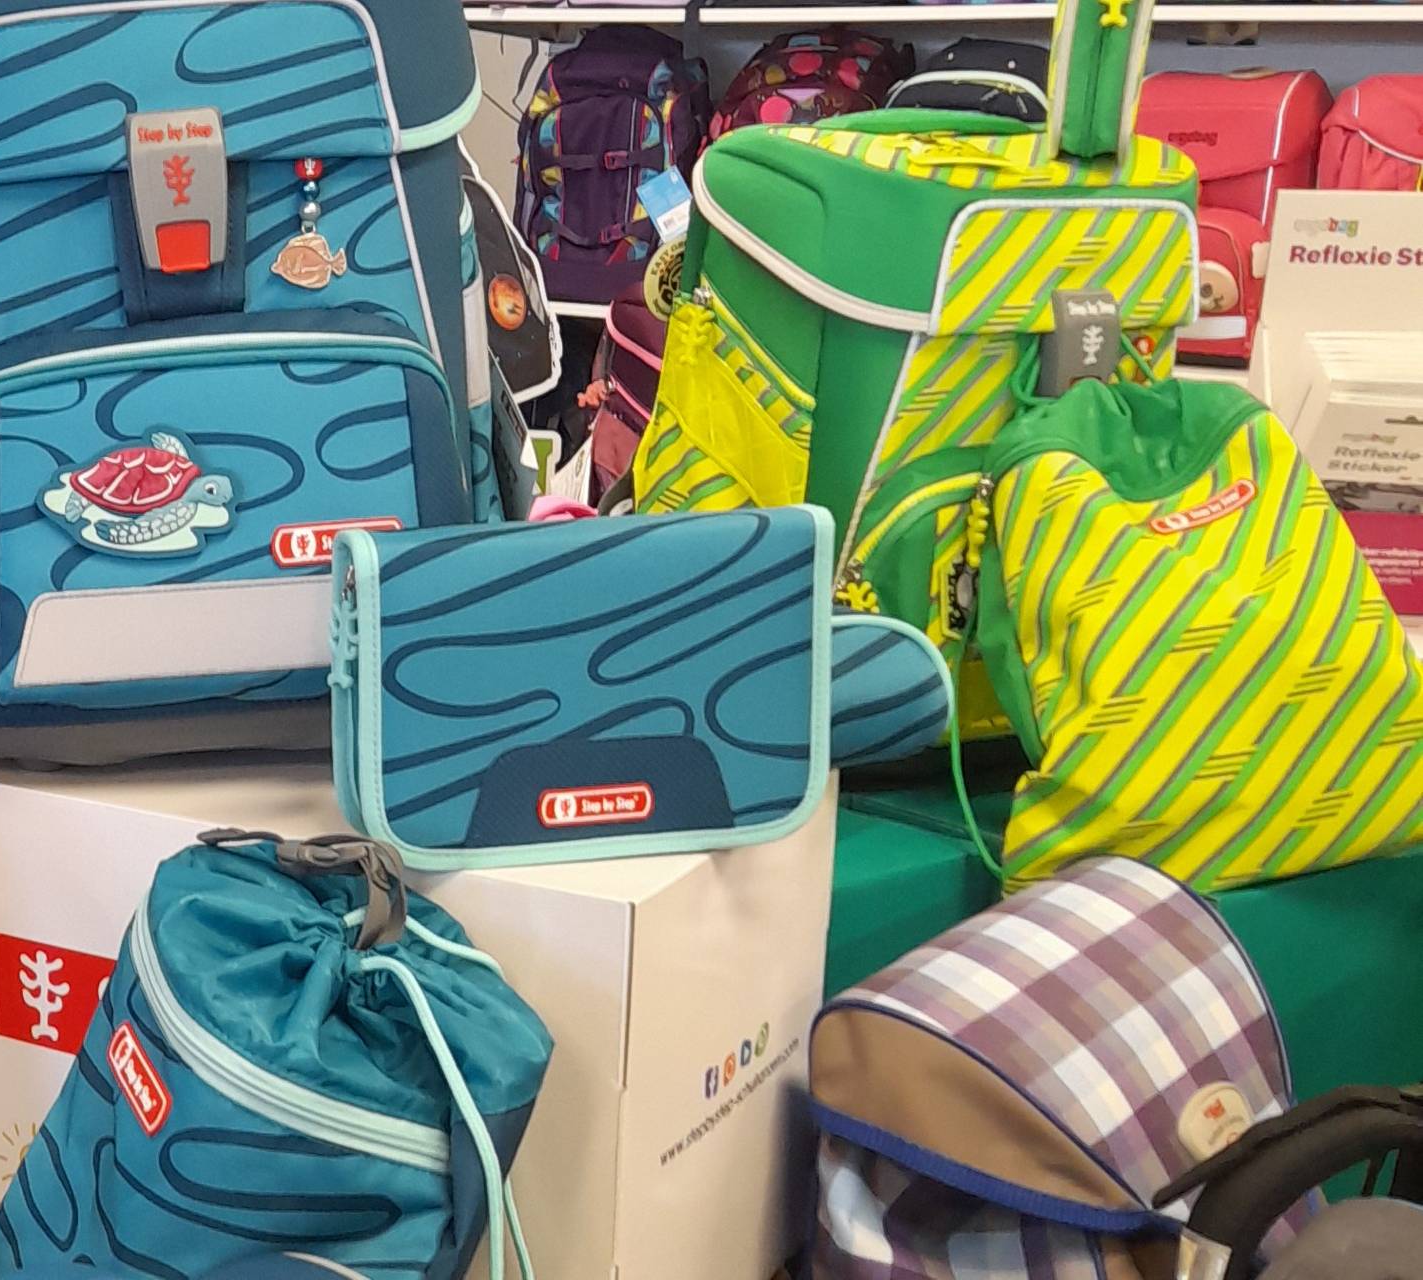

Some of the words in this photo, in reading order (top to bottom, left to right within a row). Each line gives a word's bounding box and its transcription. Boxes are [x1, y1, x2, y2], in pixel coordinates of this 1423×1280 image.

[136, 126, 164, 144] Step
[166, 122, 183, 142] by
[185, 120, 214, 138] Step
[1288, 245, 1393, 266] Reflexie
[1396, 247, 1423, 267] St
[321, 534, 333, 551] St
[581, 797, 601, 813] Step
[603, 796, 615, 812] by
